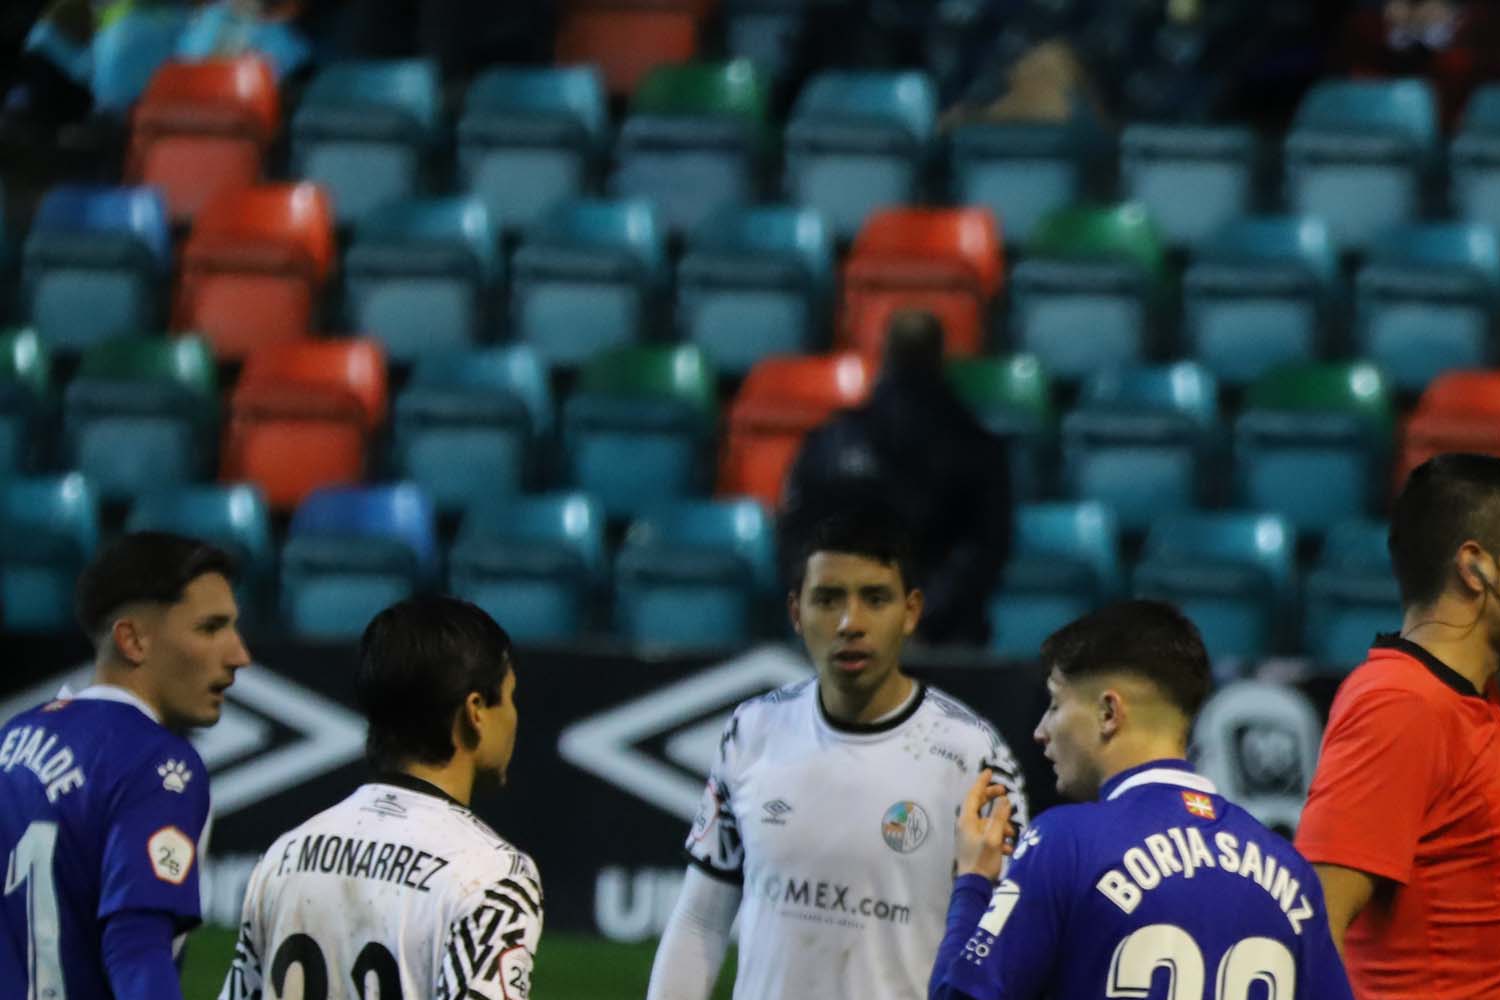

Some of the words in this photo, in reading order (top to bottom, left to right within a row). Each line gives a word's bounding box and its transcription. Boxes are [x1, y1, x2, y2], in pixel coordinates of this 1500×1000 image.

[297, 834, 449, 893] MONARREZ
[1096, 827, 1215, 915] BORJA
[1214, 831, 1314, 935] SAINZ
